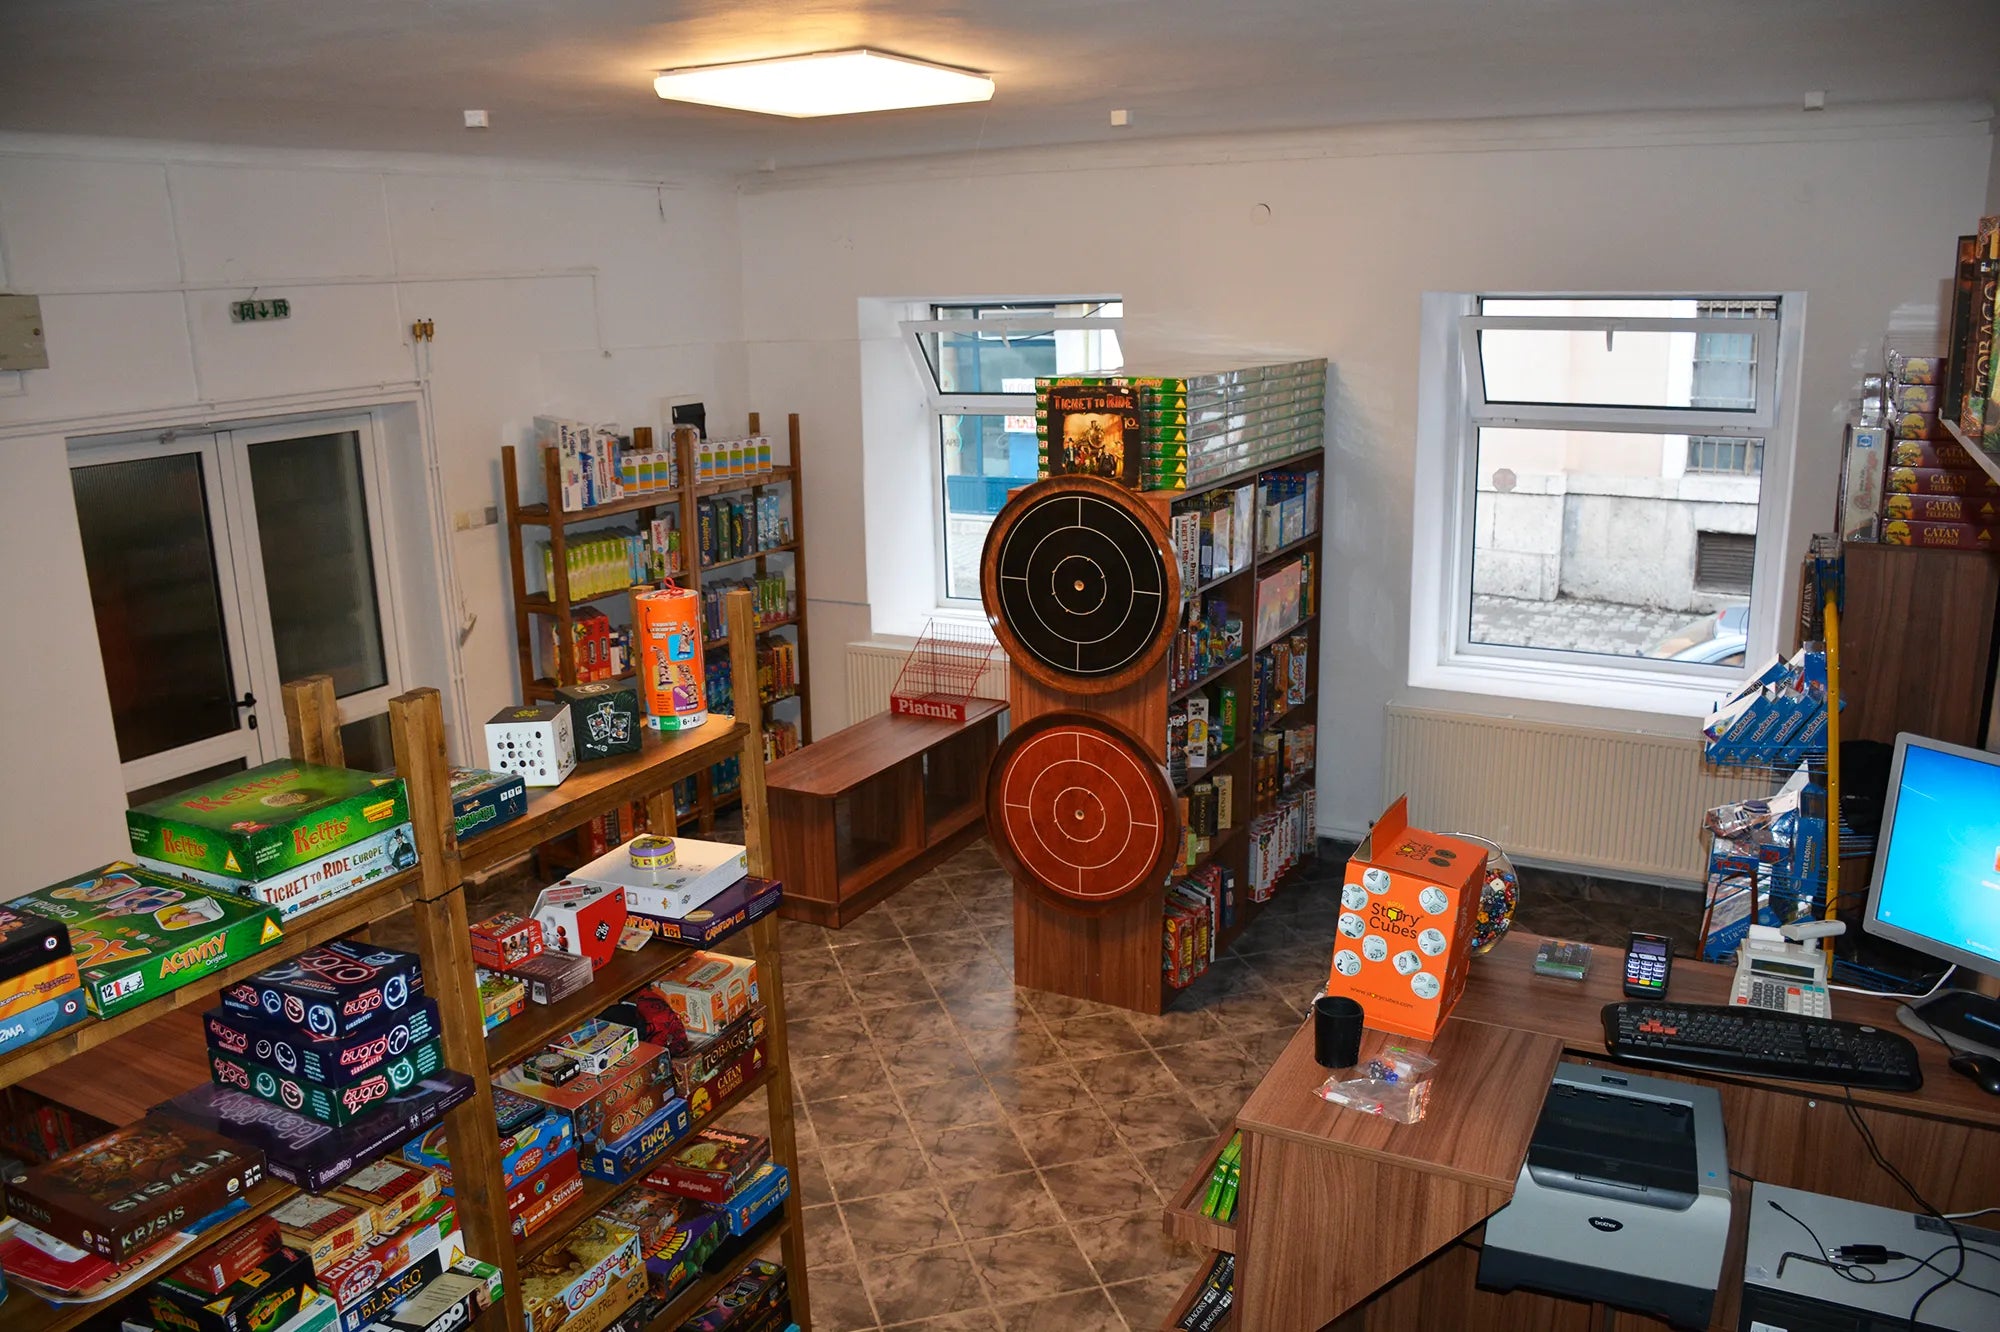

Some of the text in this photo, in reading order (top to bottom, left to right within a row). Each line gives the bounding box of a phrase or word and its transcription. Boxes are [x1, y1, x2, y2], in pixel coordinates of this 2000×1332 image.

[1053, 394, 1134, 411] TICKET TO RIDE
[1926, 500, 1962, 511] CATAN
[1923, 527, 1960, 538] CATAN
[898, 700, 958, 720] Piatnik
[161, 828, 206, 858] Keltis
[292, 817, 349, 855] Keltis
[263, 846, 384, 904] TICKET TO RIDE EUROPE
[1369, 916, 1418, 940] Cubes
[160, 931, 227, 980] ACTIVITY
[206, 952, 228, 967] Original
[702, 1029, 749, 1070] TOBAGO
[717, 1063, 742, 1091] CATAN
[640, 1121, 671, 1153] FINCA
[8, 1195, 52, 1223] KRYSIS
[120, 1206, 186, 1250] KRYSIS
[1594, 1220, 1618, 1230] brother
[361, 1269, 422, 1320] BLANKO
[1184, 1300, 1207, 1328] DRAGONS
[1200, 1305, 1223, 1332] DRAGONS
